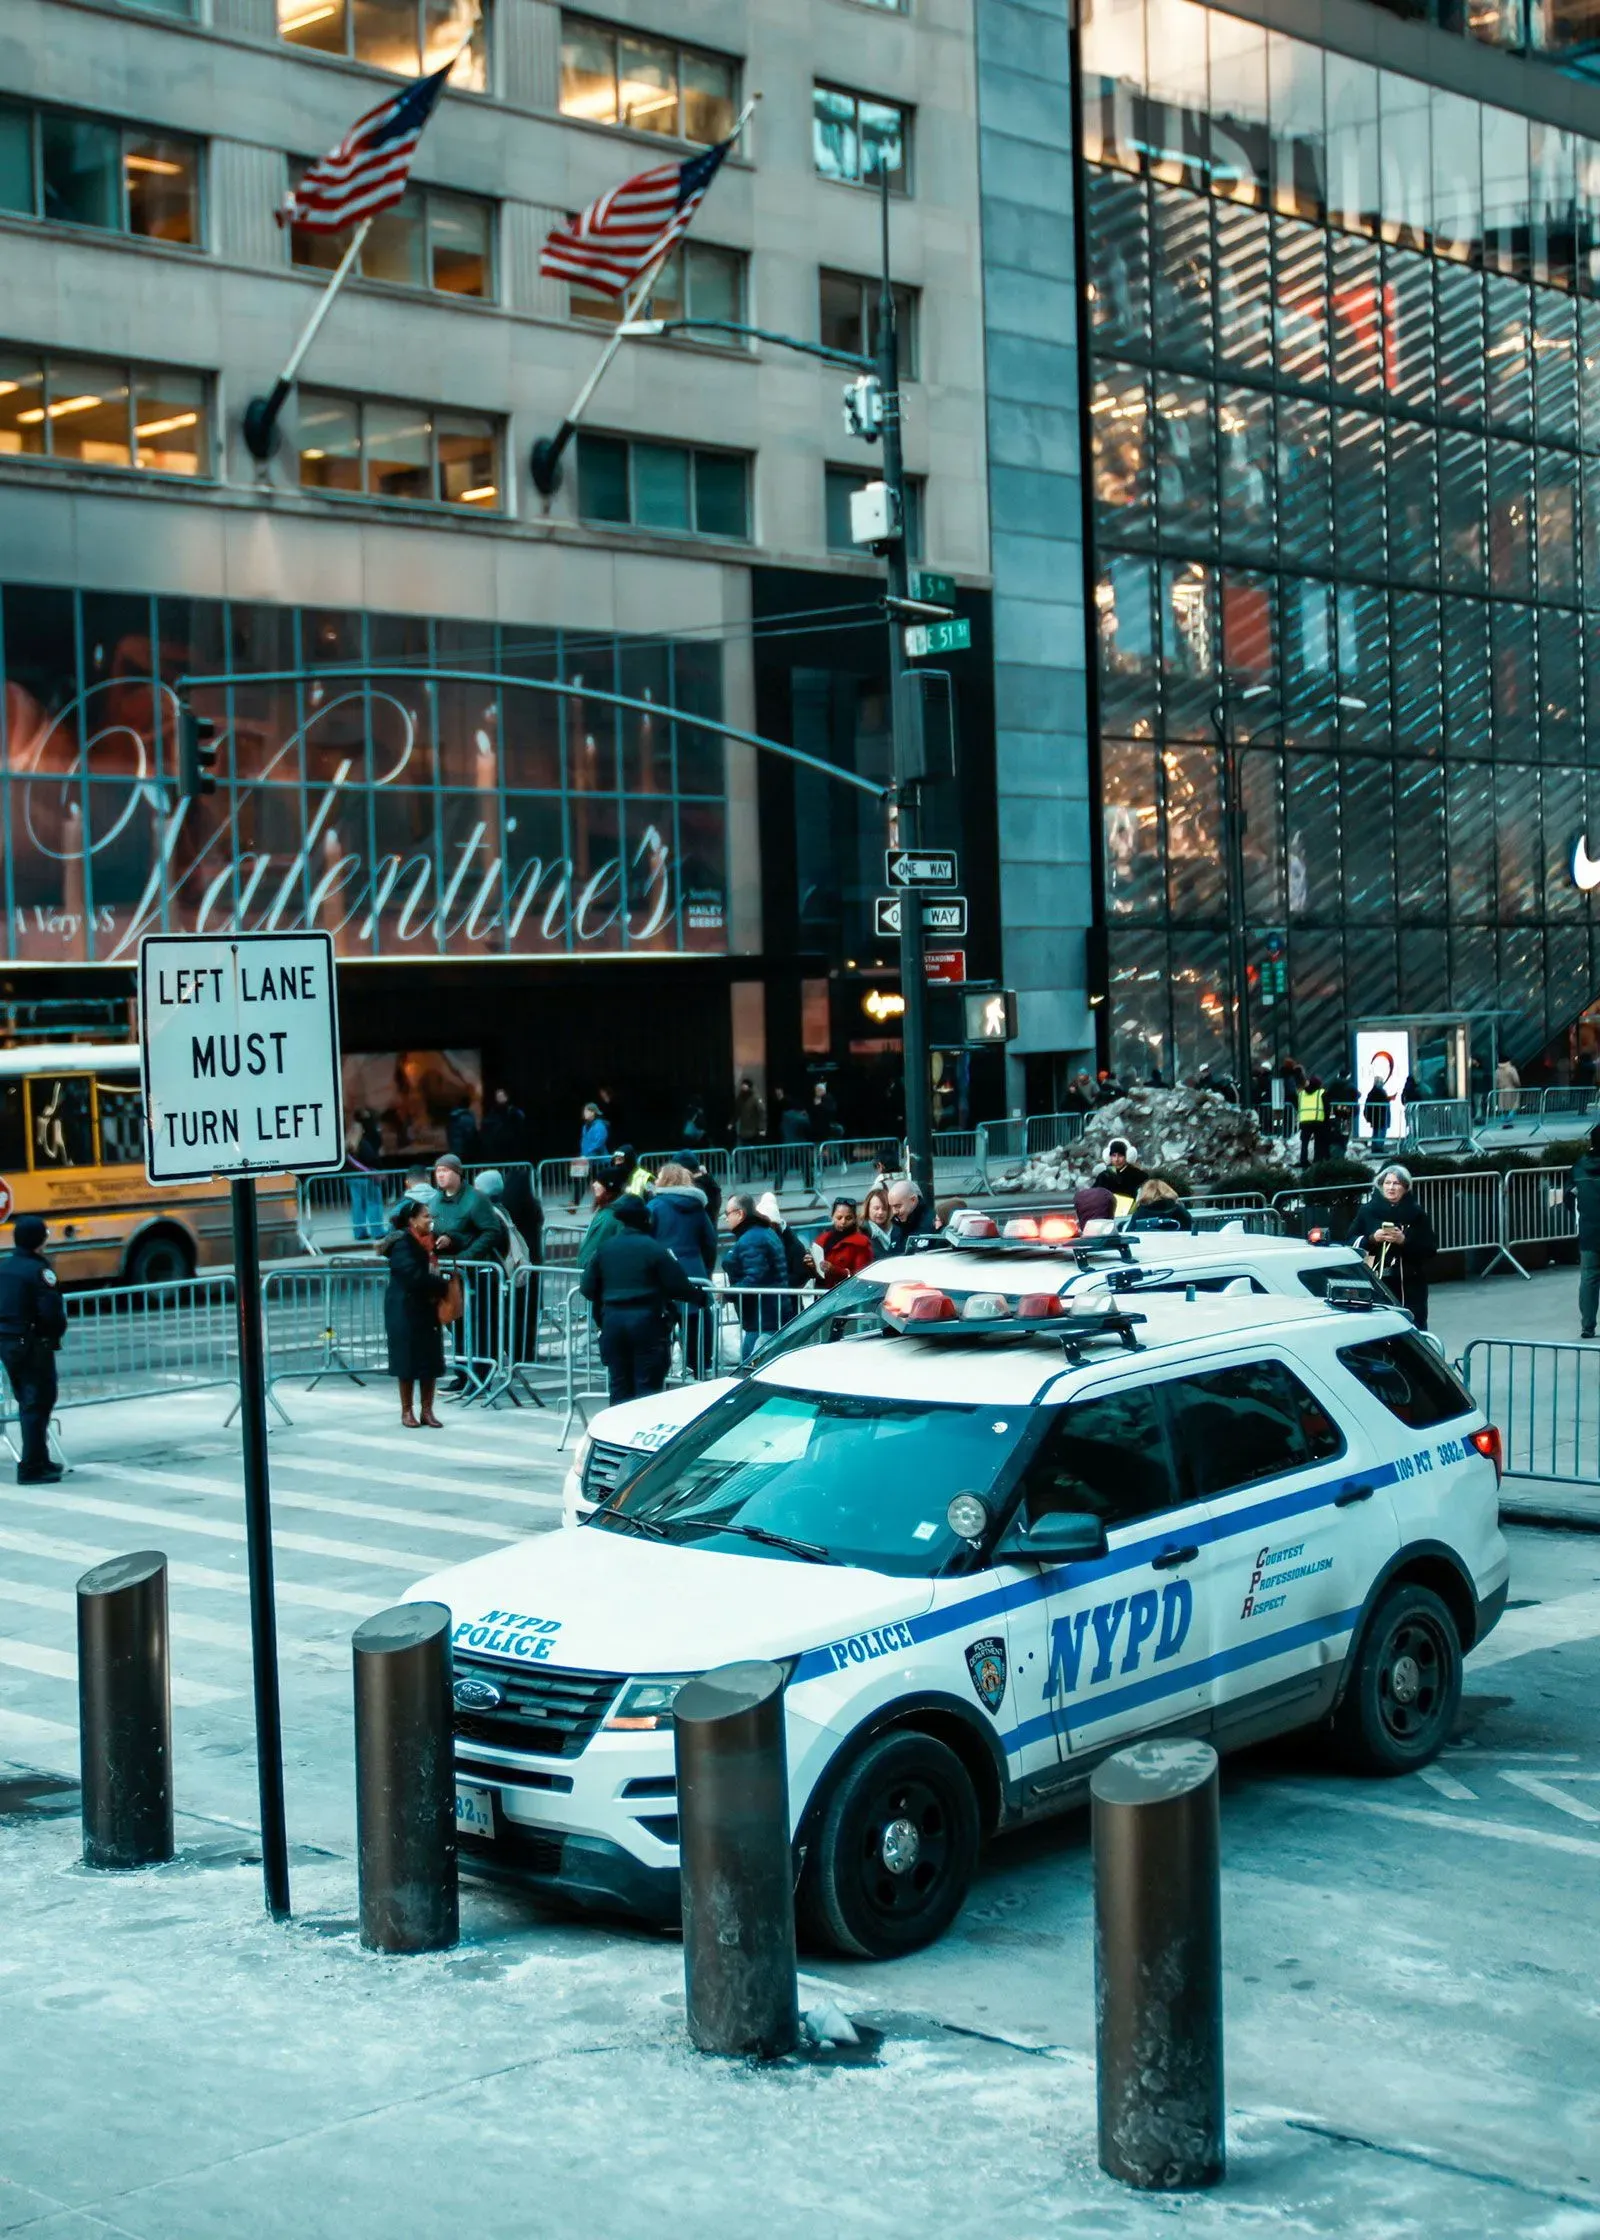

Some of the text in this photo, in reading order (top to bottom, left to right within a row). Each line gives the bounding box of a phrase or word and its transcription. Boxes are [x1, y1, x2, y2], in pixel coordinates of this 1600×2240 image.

[940, 625, 953, 648] 51
[24, 674, 686, 962] Valentine's
[900, 861, 949, 876] ONE WAY
[930, 908, 955, 923] WAY
[924, 954, 956, 963] STANDING
[159, 965, 316, 1005] LEFT LANE
[192, 1032, 287, 1079] MUST
[164, 1103, 323, 1147] TURN LEFT
[629, 1431, 668, 1449] POL
[1396, 1457, 1414, 1480] 109
[1413, 1450, 1433, 1474] PCT
[1437, 1441, 1460, 1466] 3882
[1256, 1543, 1305, 1569] COURTESY
[1249, 1557, 1334, 1594] PROFESSIONALISM
[478, 1611, 562, 1633] NYPD
[1240, 1595, 1287, 1620] RESPECT
[451, 1622, 557, 1660] POLICE
[834, 1622, 914, 1670] POLICE
[973, 1639, 995, 1653] POLICE
[1042, 1579, 1193, 1700] NYPD
